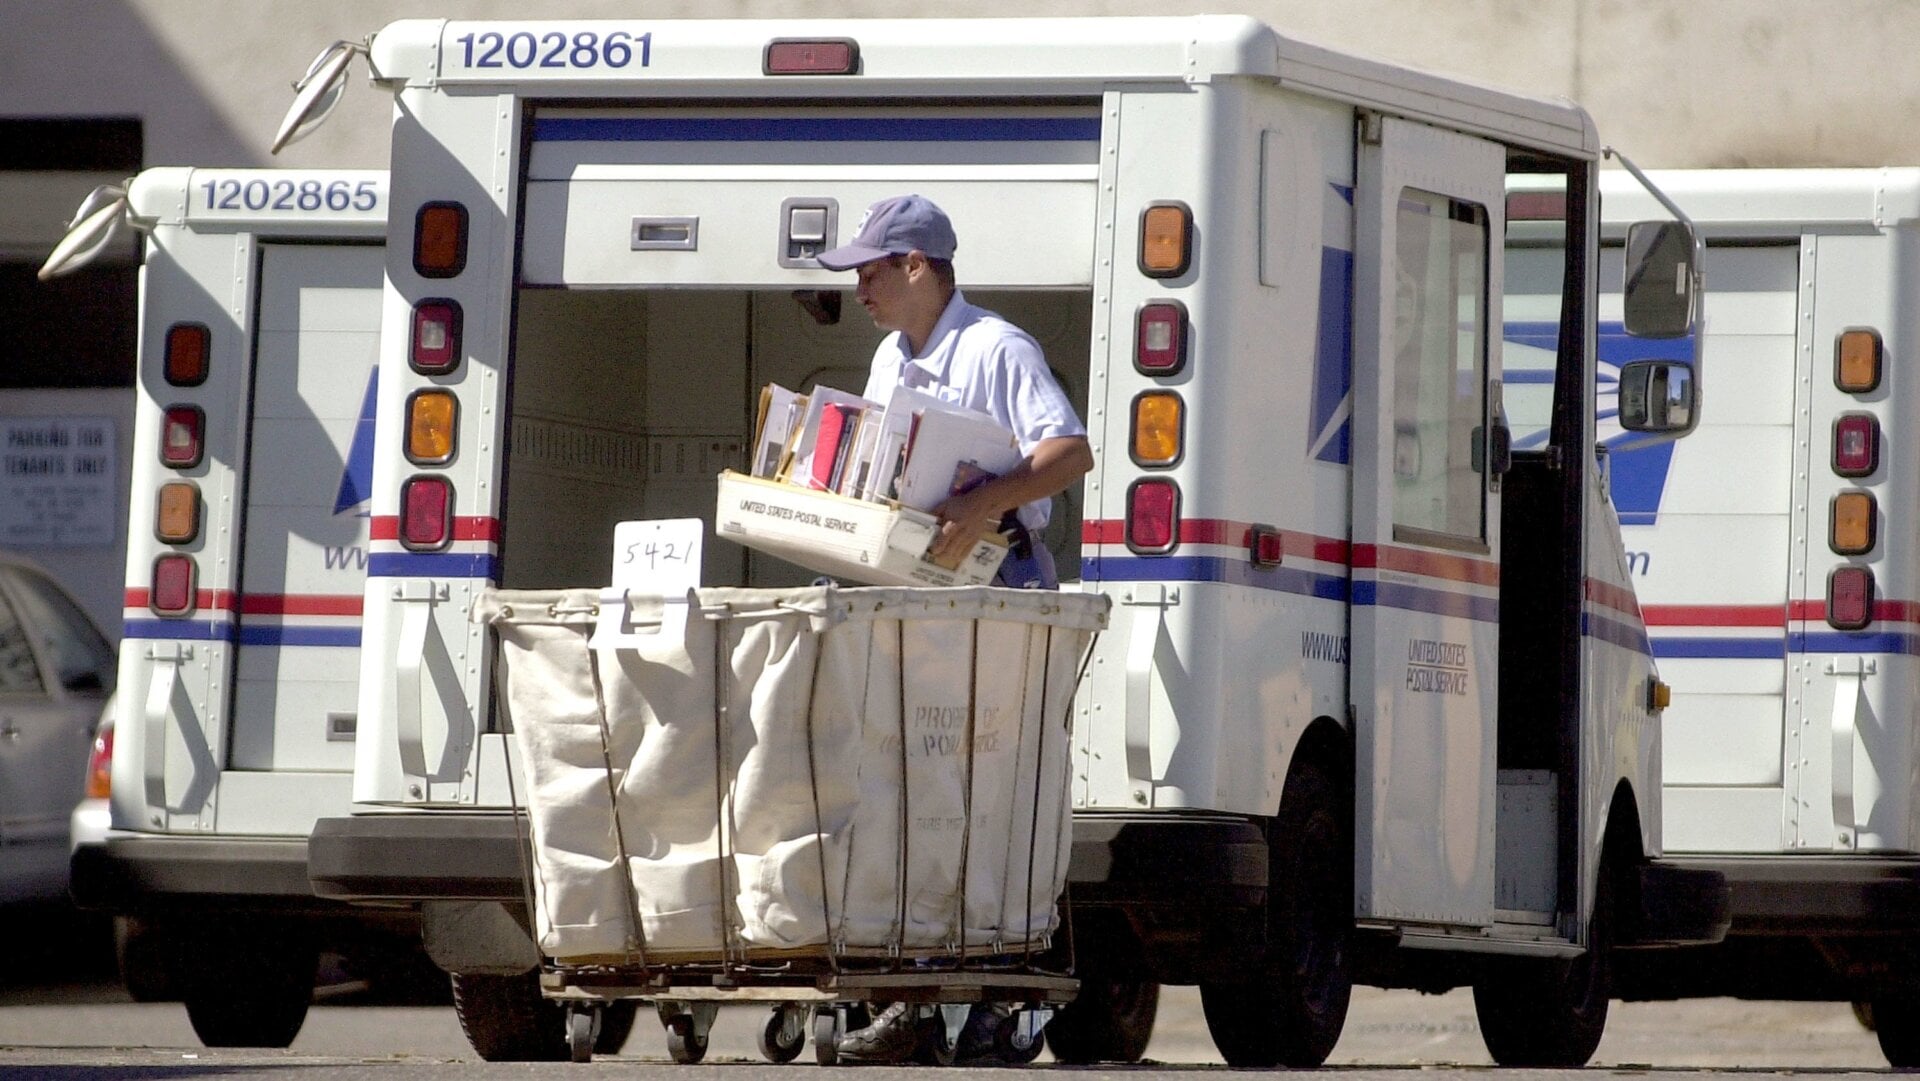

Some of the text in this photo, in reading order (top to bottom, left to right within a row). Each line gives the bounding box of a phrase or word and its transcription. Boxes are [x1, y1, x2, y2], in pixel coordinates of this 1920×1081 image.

[456, 31, 652, 69] 1202861
[201, 178, 377, 212] 1202865
[740, 500, 858, 534] UNITED STATES POSTAL SERVICE
[624, 541, 693, 570] 5421
[1408, 639, 1466, 667] UNITED STATES
[1406, 667, 1468, 696] POSTAL SERVICE
